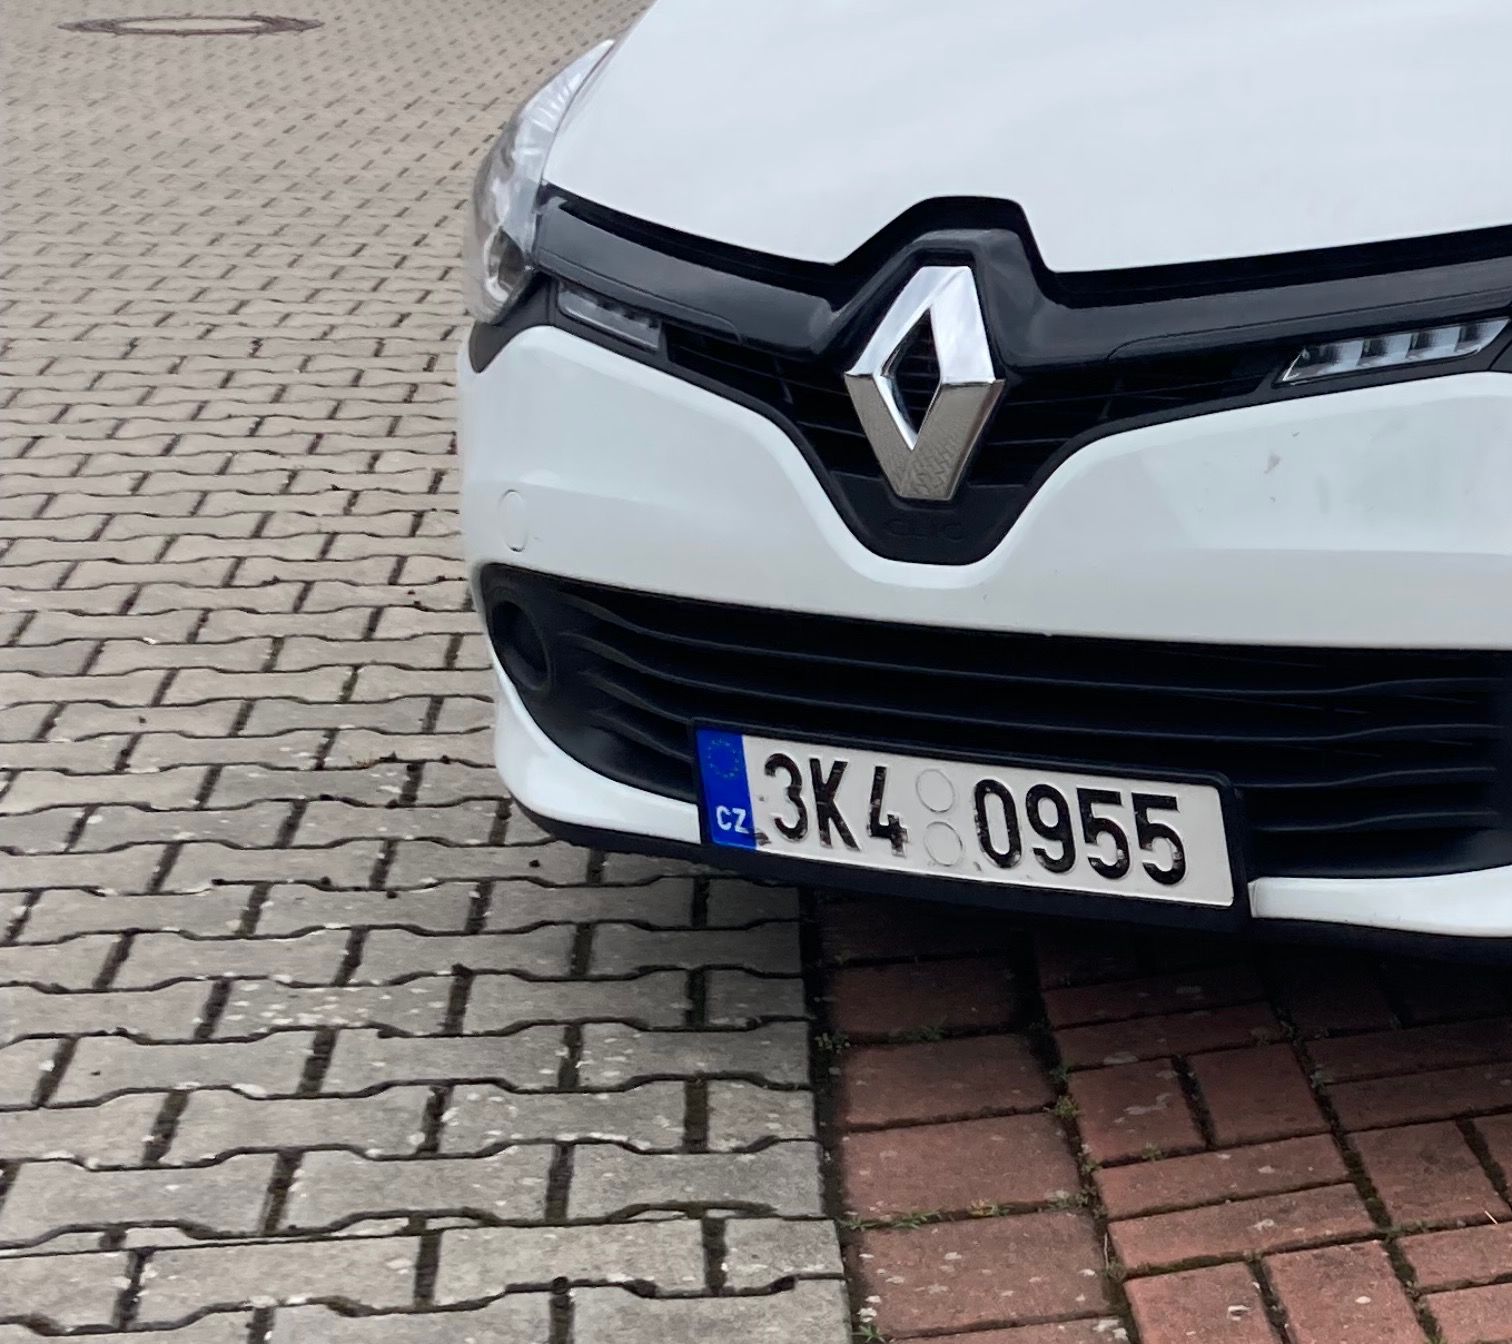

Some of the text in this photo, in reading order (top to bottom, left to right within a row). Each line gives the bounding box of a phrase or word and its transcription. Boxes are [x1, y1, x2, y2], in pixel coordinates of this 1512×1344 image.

[716, 805, 749, 834] CZ
[763, 752, 1187, 886] 3K4 0955
